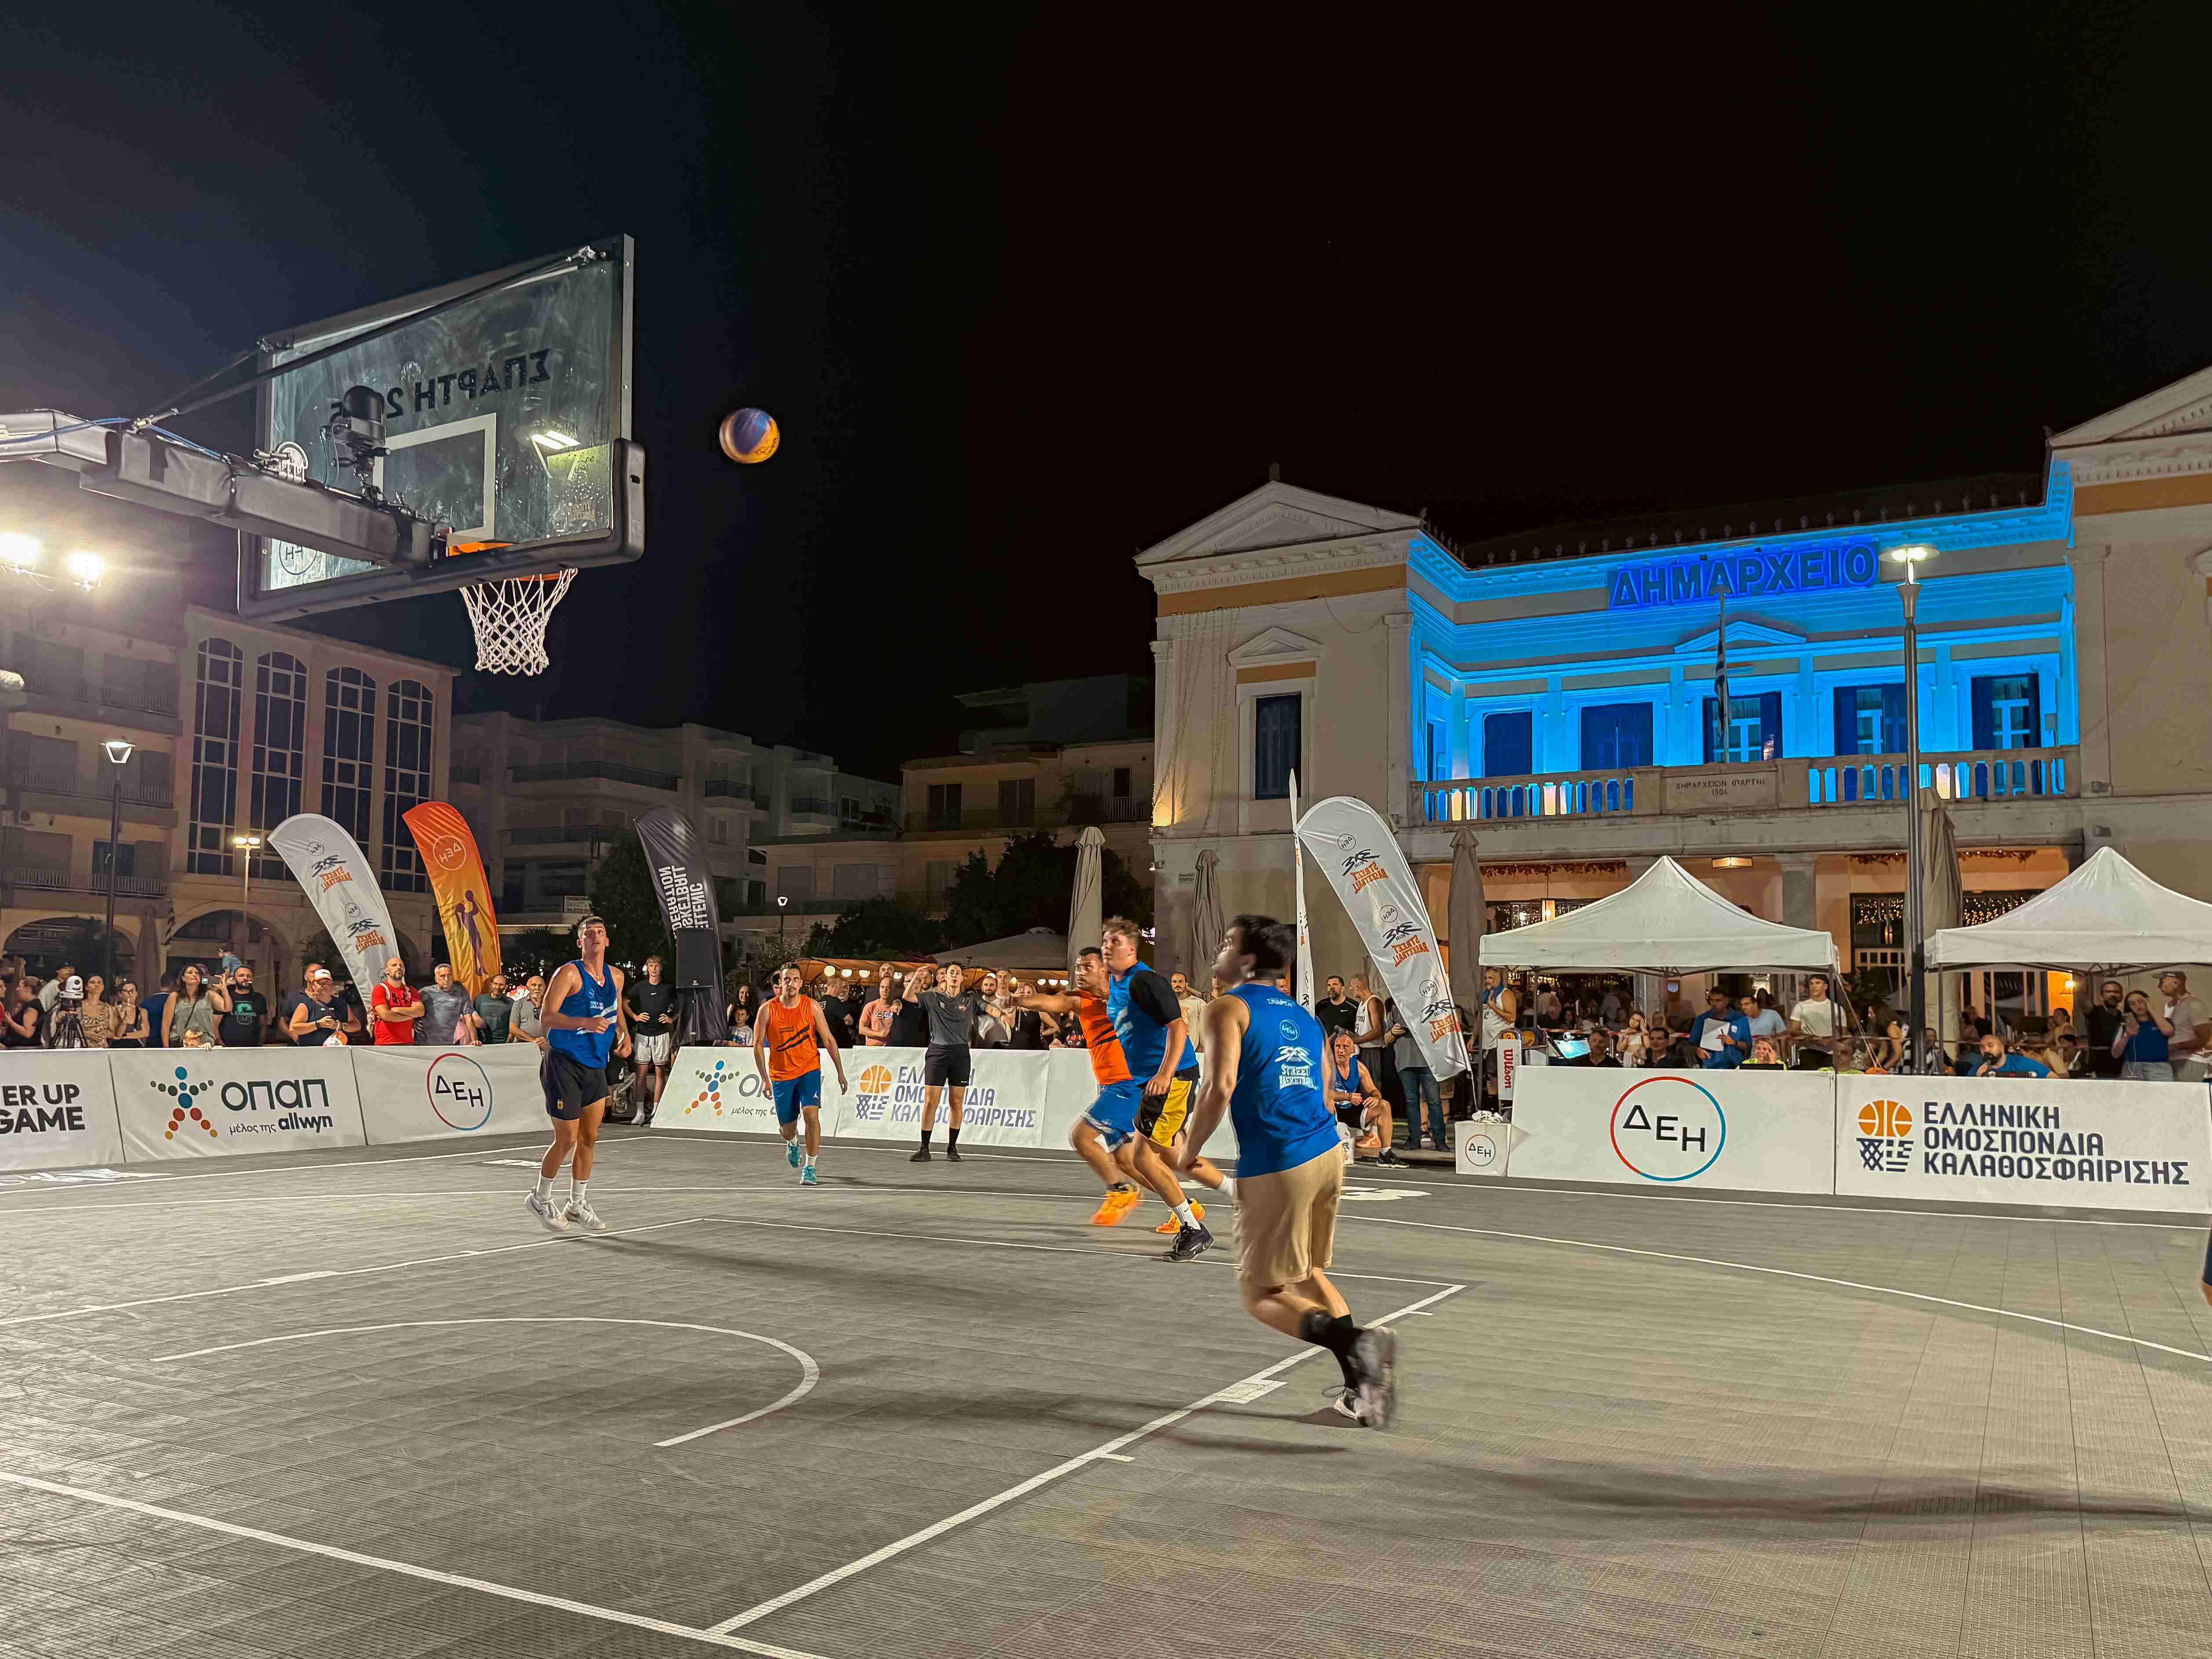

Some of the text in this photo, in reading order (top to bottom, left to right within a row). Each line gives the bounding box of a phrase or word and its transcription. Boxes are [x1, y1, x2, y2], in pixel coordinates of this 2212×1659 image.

[1612, 545, 1876, 606] ΔΗΜΑΡΧΕΙΟ
[0, 1084, 80, 1106] ER UP
[435, 1075, 484, 1107] ΔΕΗ
[229, 1112, 333, 1135] μέλος της allwyn
[731, 1106, 753, 1115] μέλος
[1924, 1102, 2060, 1129] ΕΛΛΗΝΙΚΗ
[1623, 1105, 1706, 1152] ΔΕΗ
[1924, 1127, 2103, 1156] ΟΜΟΣΠΟΝΔΙΑ
[1468, 1143, 1491, 1157] ΔΕΗ
[1924, 1152, 2190, 1185] ΚΑΛΑΘΟΣΦΑΙΡΙΣΗΣ
